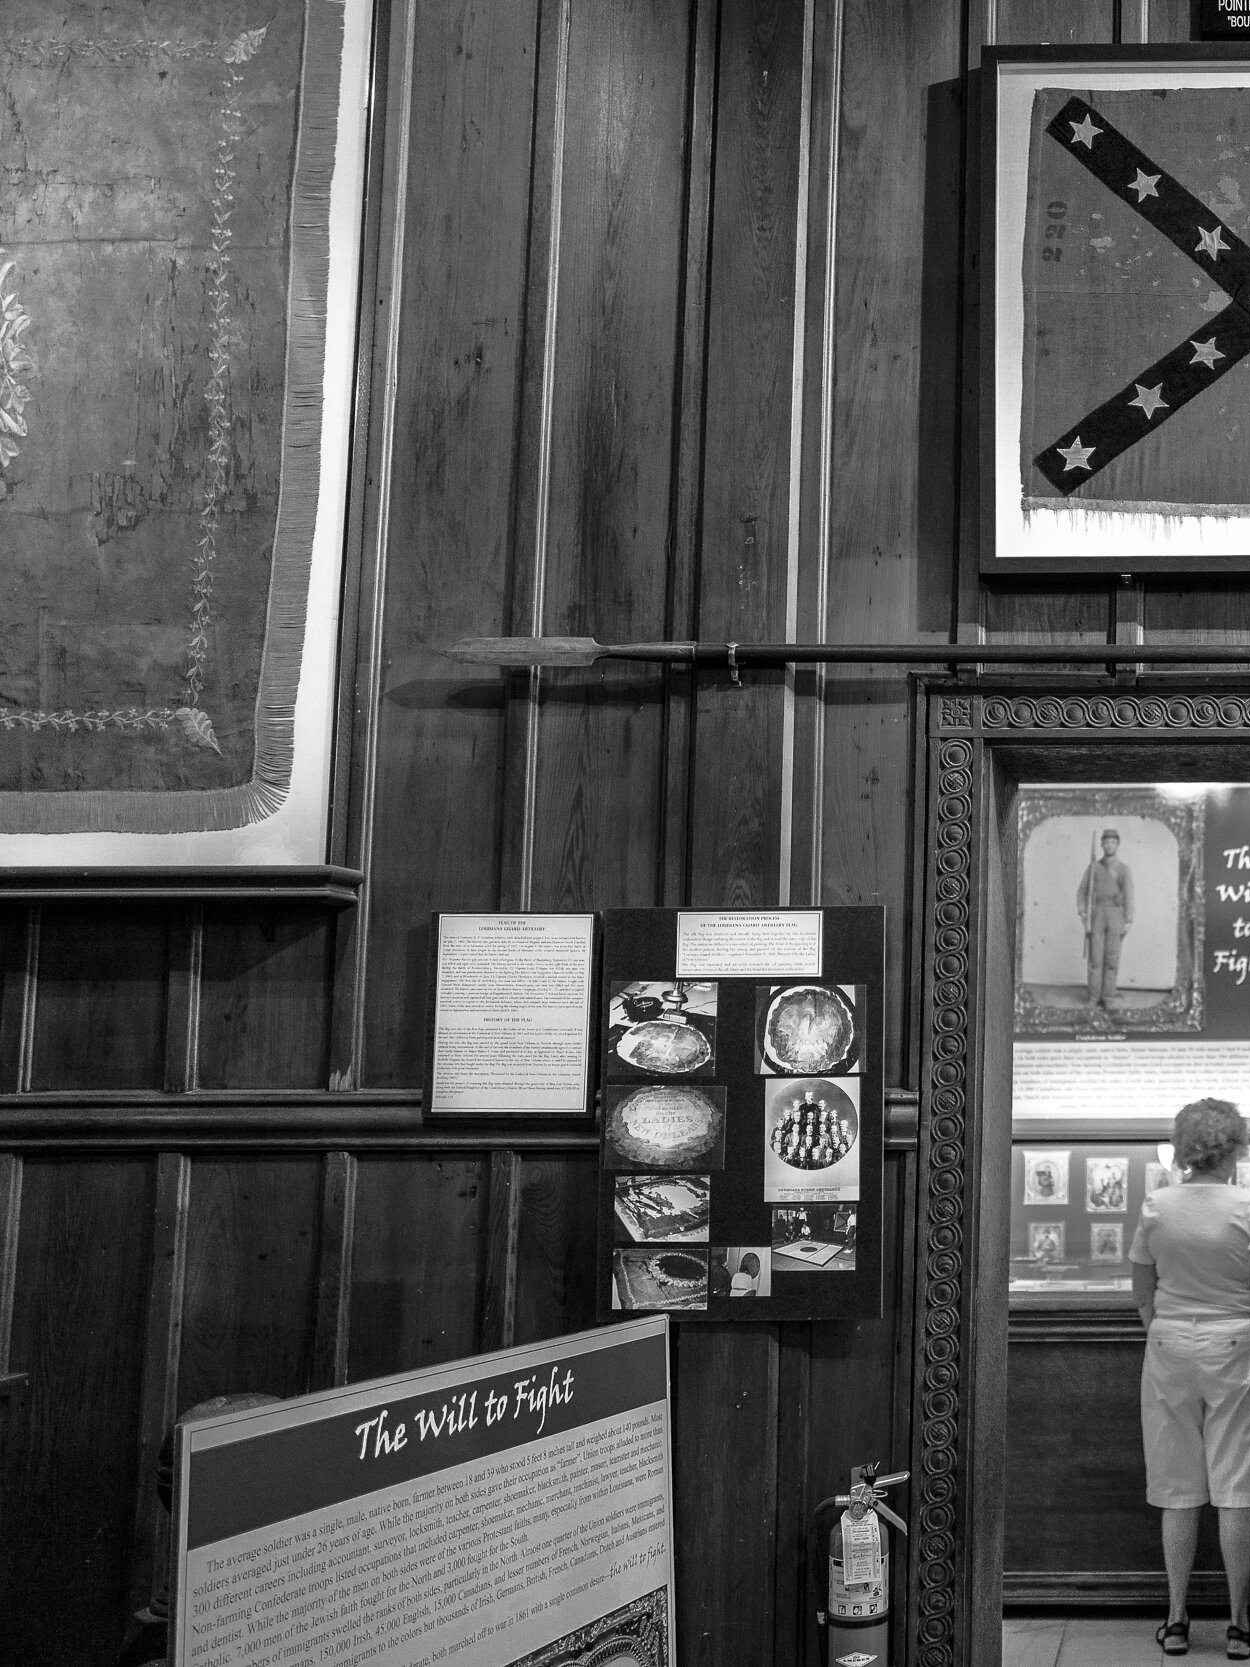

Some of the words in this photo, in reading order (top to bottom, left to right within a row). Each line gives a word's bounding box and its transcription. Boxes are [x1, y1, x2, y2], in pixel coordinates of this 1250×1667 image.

[642, 1115, 693, 1123] LADIES
[355, 1409, 408, 1460] The
[414, 1390, 478, 1441] Will
[485, 1390, 508, 1426] to
[513, 1366, 574, 1434] Fight
[192, 1599, 210, 1617] 300
[212, 1587, 252, 1609] different
[254, 1575, 285, 1594] careers
[287, 1561, 326, 1582] including
[373, 1532, 407, 1551] surveyor,
[409, 1516, 444, 1538] locksmith,
[445, 1509, 470, 1524] teacher,
[472, 1498, 502, 1515] carpenter,
[503, 1485, 536, 1503] shoemaker,
[630, 1446, 639, 1457] and
[193, 1577, 229, 1597] soldiers
[231, 1558, 271, 1584] averaged
[272, 1555, 289, 1573] just
[291, 1546, 315, 1563] under
[317, 1539, 327, 1553] 26
[328, 1535, 350, 1552] years
[351, 1527, 361, 1541] of
[361, 1526, 376, 1539] age.
[378, 1515, 401, 1531] While
[402, 1511, 413, 1523] the
[414, 1501, 443, 1519] majority
[444, 1499, 453, 1509] on
[454, 1491, 469, 1505] both
[470, 1486, 486, 1500] sides
[487, 1482, 502, 1496] gave
[503, 1475, 517, 1488] their
[517, 1465, 548, 1483] occupation
[549, 1463, 556, 1472] as
[582, 1448, 599, 1460] Union
[599, 1443, 615, 1454] troops
[615, 1434, 633, 1449] alluded
[639, 1430, 652, 1440] more
[652, 1426, 663, 1435] than
[206, 1558, 224, 1573] The
[226, 1547, 261, 1566] average
[263, 1536, 292, 1554] soldier
[293, 1530, 310, 1543] was
[312, 1528, 317, 1537] a
[318, 1518, 344, 1535] single,
[346, 1510, 367, 1526] male,
[368, 1503, 391, 1518] native
[392, 1497, 411, 1510] born,
[412, 1489, 435, 1503] farmer
[436, 1480, 463, 1495] between
[465, 1474, 472, 1485] 18
[473, 1469, 485, 1483] and
[486, 1467, 494, 1479] 39
[495, 1463, 508, 1475] who
[509, 1456, 525, 1471] stood
[526, 1454, 530, 1465] 5
[531, 1452, 542, 1464] feet
[547, 1445, 565, 1458] inches
[565, 1440, 574, 1452] tall
[575, 1436, 585, 1448] and
[585, 1429, 607, 1444] weighed
[607, 1426, 621, 1438] about
[650, 1413, 662, 1423] Most
[236, 1638, 261, 1658] 7,000
[263, 1633, 282, 1647] men
[284, 1623, 294, 1639] of
[295, 1621, 308, 1634] the
[310, 1607, 338, 1628] Jewish
[340, 1599, 357, 1616] faith
[359, 1590, 384, 1608] fought
[386, 1585, 397, 1597] for
[398, 1580, 410, 1592] the
[411, 1570, 431, 1587] North
[432, 1563, 445, 1578] and
[446, 1556, 465, 1573] 3,000
[466, 1548, 487, 1565] fought
[488, 1544, 498, 1556] for
[499, 1540, 509, 1551] the
[509, 1532, 529, 1547] South.
[432, 1646, 447, 1663] both
[448, 1631, 475, 1654] marched
[476, 1626, 487, 1640] off
[487, 1626, 494, 1635] to
[494, 1620, 507, 1632] war
[507, 1615, 513, 1626] in
[515, 1607, 528, 1622] 1861
[530, 1601, 543, 1614] with
[544, 1601, 548, 1609] a
[548, 1591, 565, 1607] single
[565, 1582, 588, 1599] common
[622, 1553, 638, 1571] will
[639, 1550, 646, 1563] to
